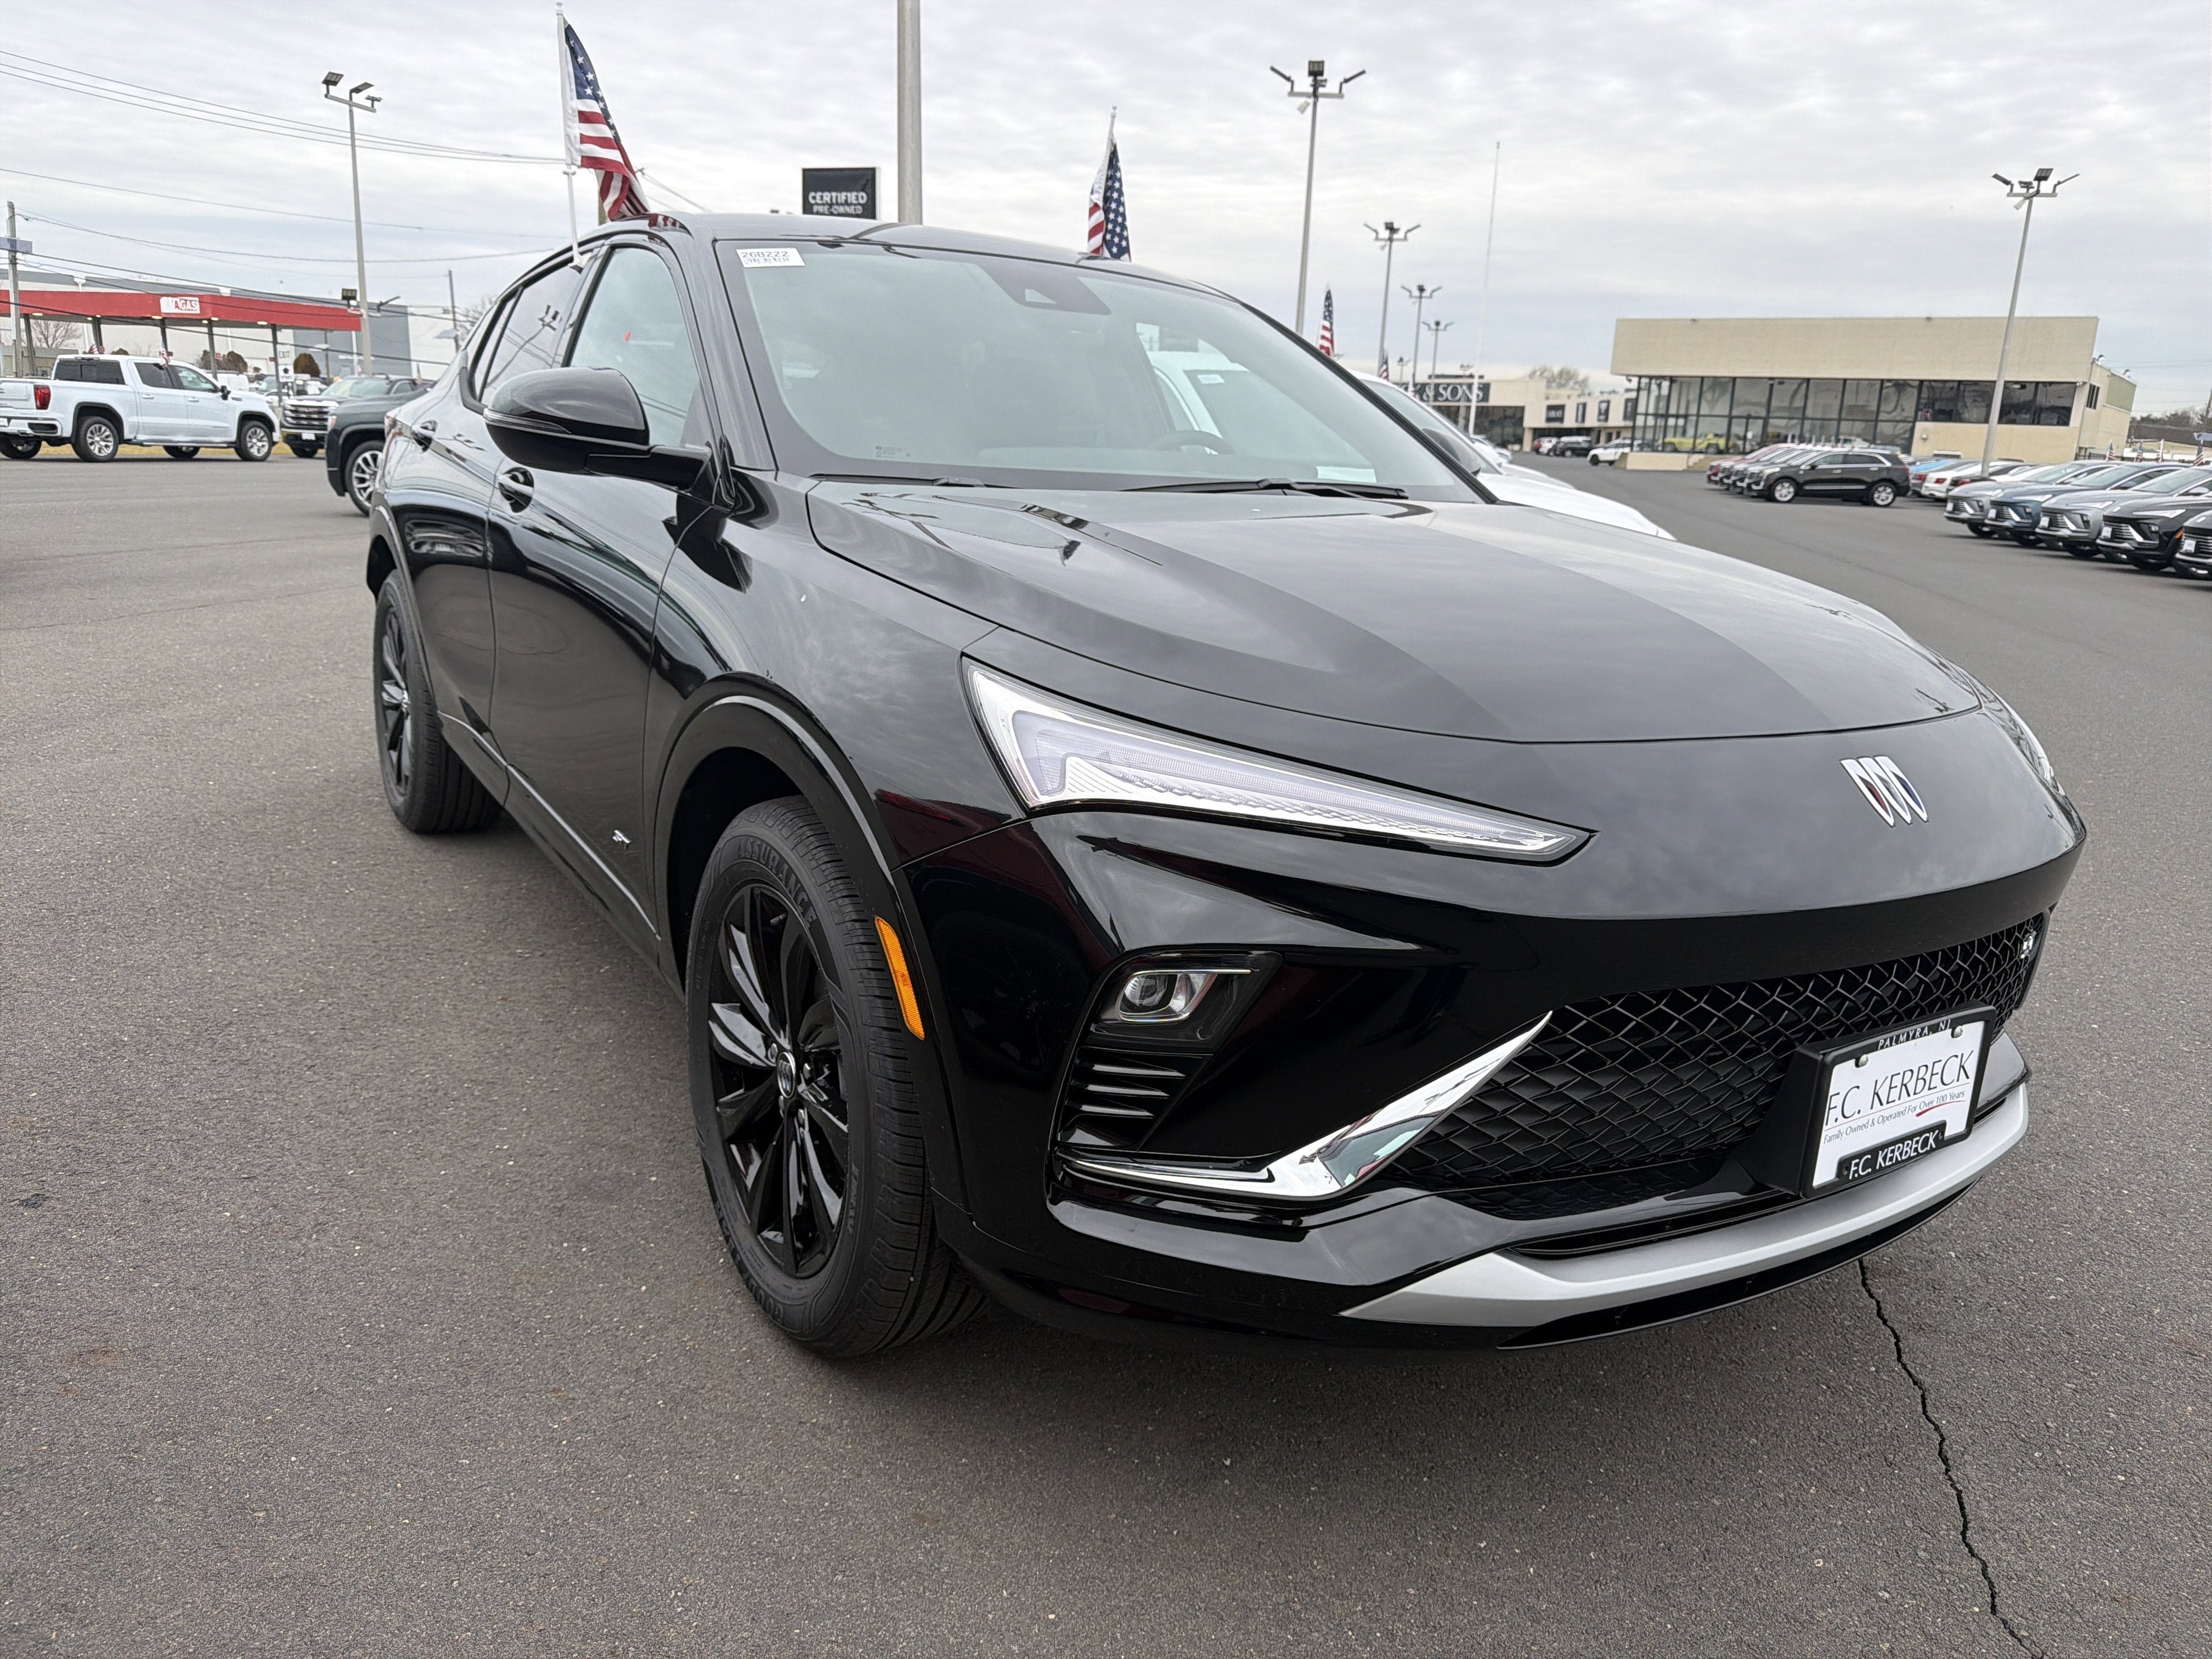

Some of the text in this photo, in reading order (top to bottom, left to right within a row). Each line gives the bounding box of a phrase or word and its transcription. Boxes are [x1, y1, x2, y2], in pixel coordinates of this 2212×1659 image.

[808, 191, 867, 204] CERTIFIED
[812, 205, 863, 215] PRE-OWNED
[1437, 383, 1483, 401] SONS
[1877, 1025, 1932, 1050] PALMYRA,
[1825, 1050, 1974, 1126] F.C. KERBECK
[1823, 1091, 1965, 1144] Family Owned & Operated For Over 100 Years
[1849, 1130, 1939, 1180] F.C. KERBECK
